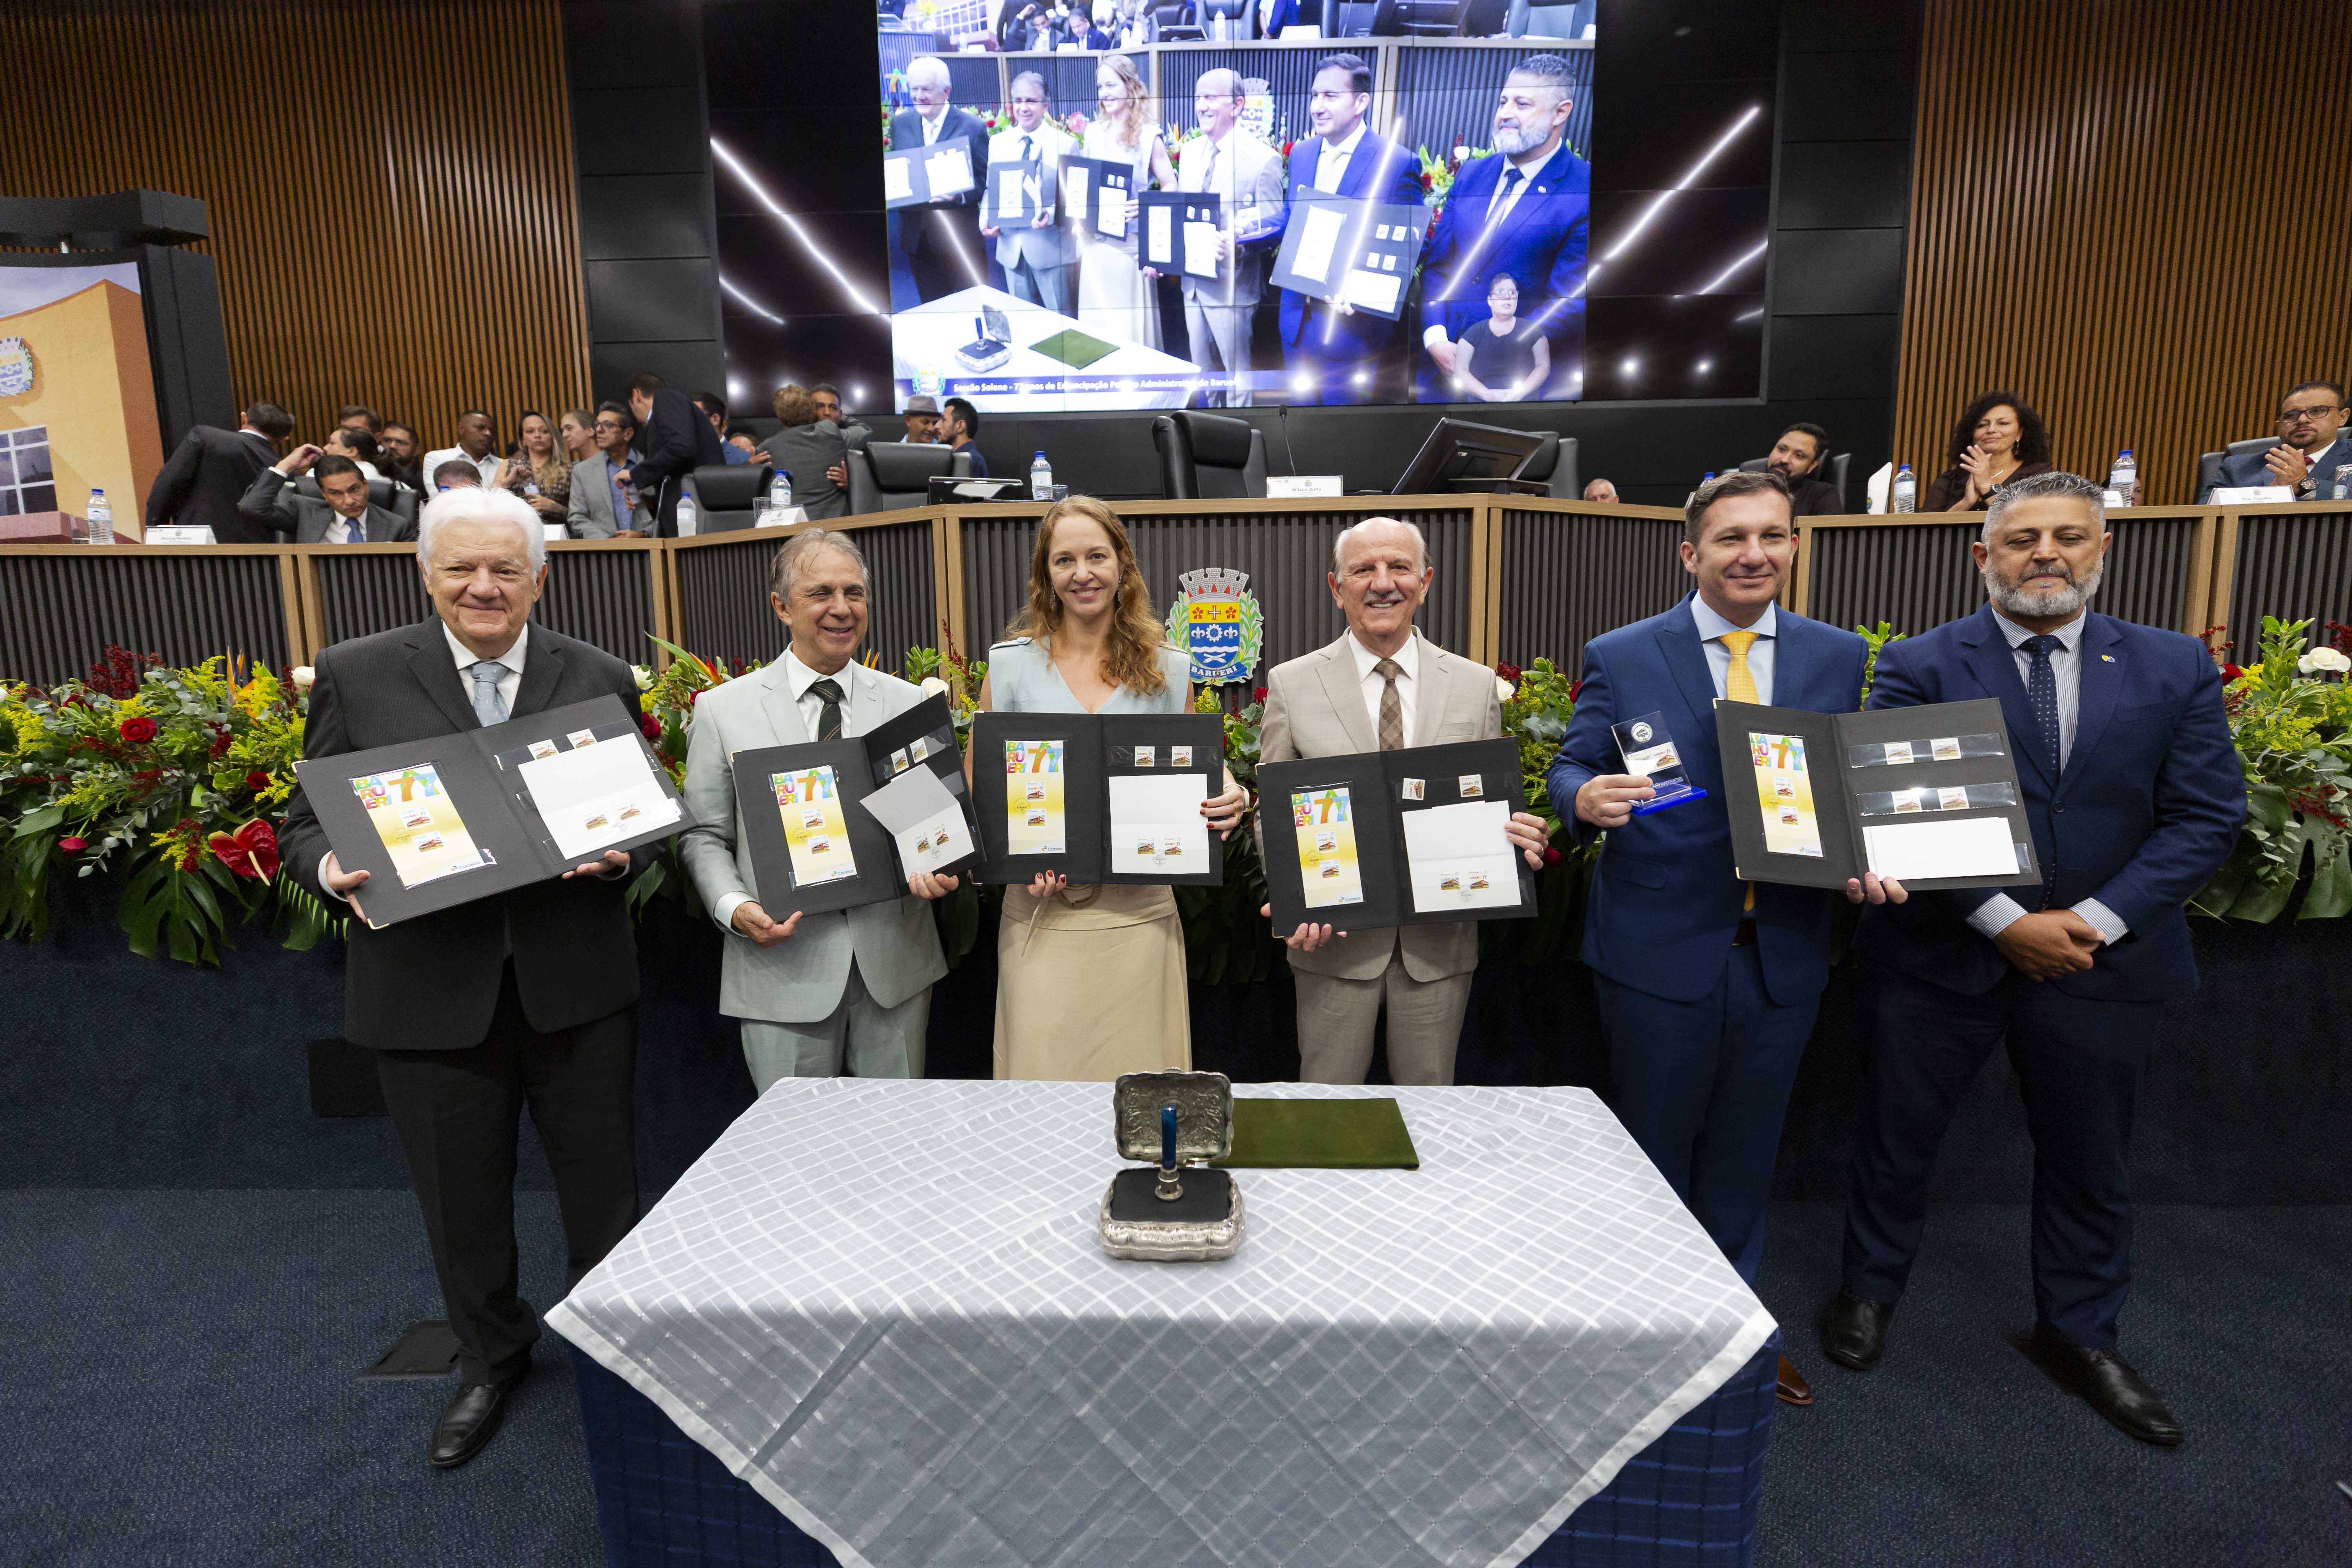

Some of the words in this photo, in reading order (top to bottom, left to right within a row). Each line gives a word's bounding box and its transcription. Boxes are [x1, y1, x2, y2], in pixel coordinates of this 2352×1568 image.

[953, 382, 980, 392] Sessão
[981, 382, 1007, 391] Solene
[1198, 378, 1209, 387] de
[1007, 742, 1025, 752] BA
[1007, 751, 1025, 762] RU
[1755, 755, 1771, 767] ERI
[1007, 763, 1026, 773] ERI
[355, 776, 383, 790] BA
[774, 774, 793, 785] BA
[1655, 776, 1684, 788] Correios
[360, 786, 386, 800] RU
[777, 782, 795, 795] RU
[365, 795, 392, 810] ERI
[779, 792, 798, 806] ERI
[1293, 793, 1311, 805] BA
[1294, 803, 1312, 816] RU
[1296, 814, 1314, 827] ERI
